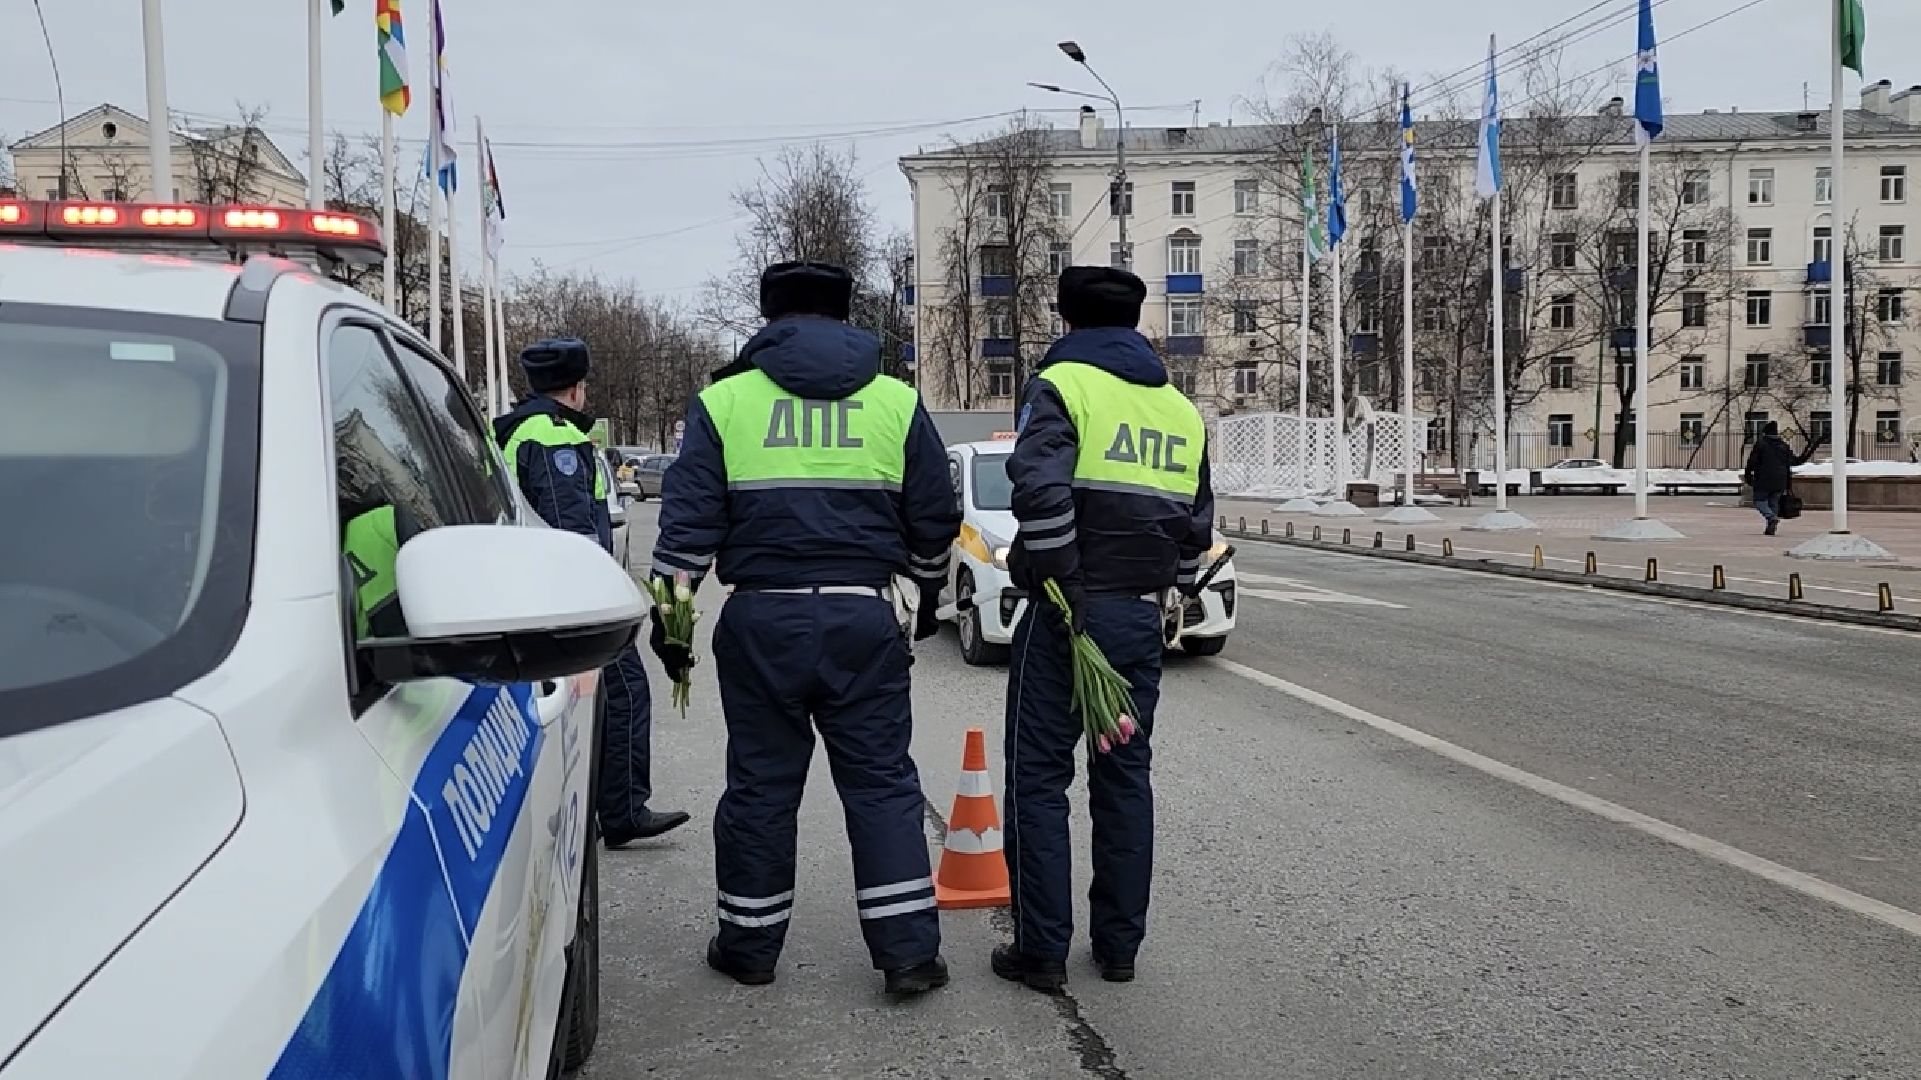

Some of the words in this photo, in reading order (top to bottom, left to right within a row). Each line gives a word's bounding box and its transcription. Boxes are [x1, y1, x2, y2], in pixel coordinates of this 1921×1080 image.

[763, 399, 863, 448] ДПС
[1104, 423, 1188, 473] ДПС
[442, 684, 530, 861] ПОЛИЦИЯ
